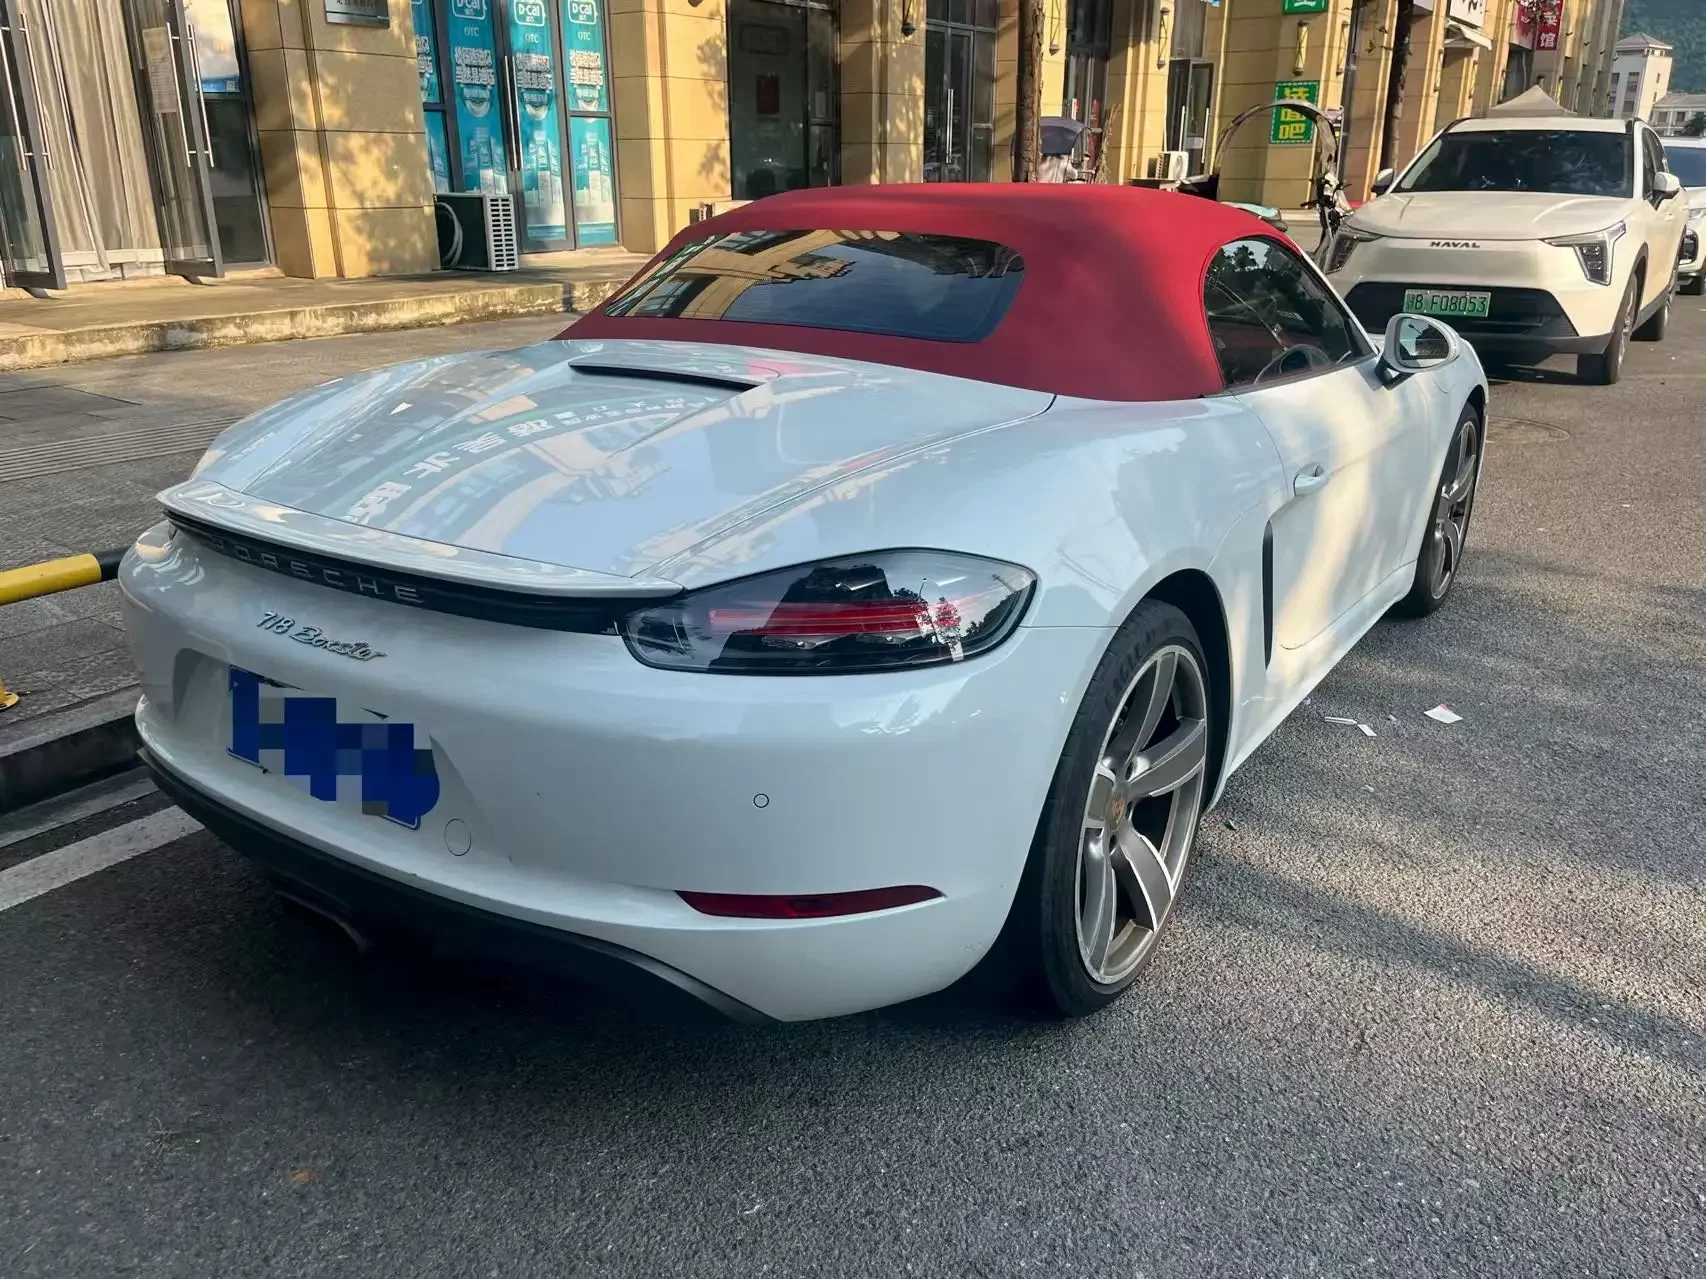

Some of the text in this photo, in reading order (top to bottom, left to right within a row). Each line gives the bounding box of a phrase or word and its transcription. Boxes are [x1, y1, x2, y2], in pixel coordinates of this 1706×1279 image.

[463, 25, 480, 37] OTC
[577, 31, 592, 42] OTC
[524, 33, 540, 44] OTC
[1430, 241, 1480, 249] HAVAL
[1430, 295, 1487, 313] F08053
[210, 534, 424, 605] PORSCHE
[256, 611, 387, 661] 718 Boxster
